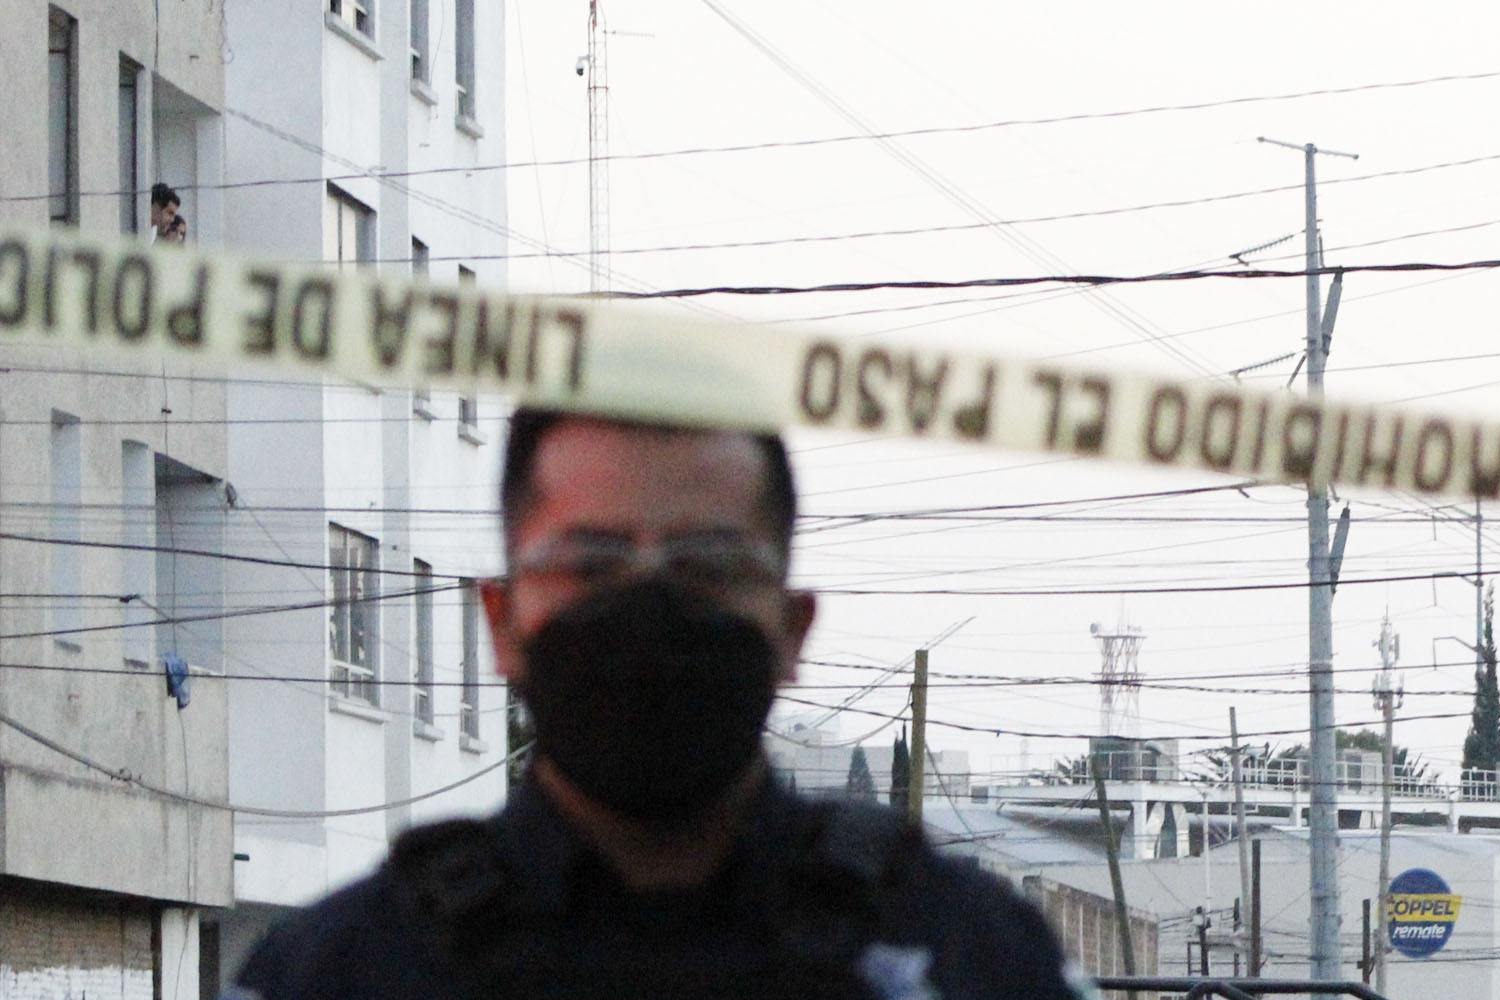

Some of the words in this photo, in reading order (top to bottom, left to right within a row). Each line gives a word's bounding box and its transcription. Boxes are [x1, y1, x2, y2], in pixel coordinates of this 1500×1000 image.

[0, 238, 210, 347] POLIC
[241, 270, 333, 360] DE
[372, 281, 590, 391] LINEA
[802, 341, 994, 438] PASO
[1035, 370, 1112, 451] EL
[1392, 922, 1446, 939] remate
